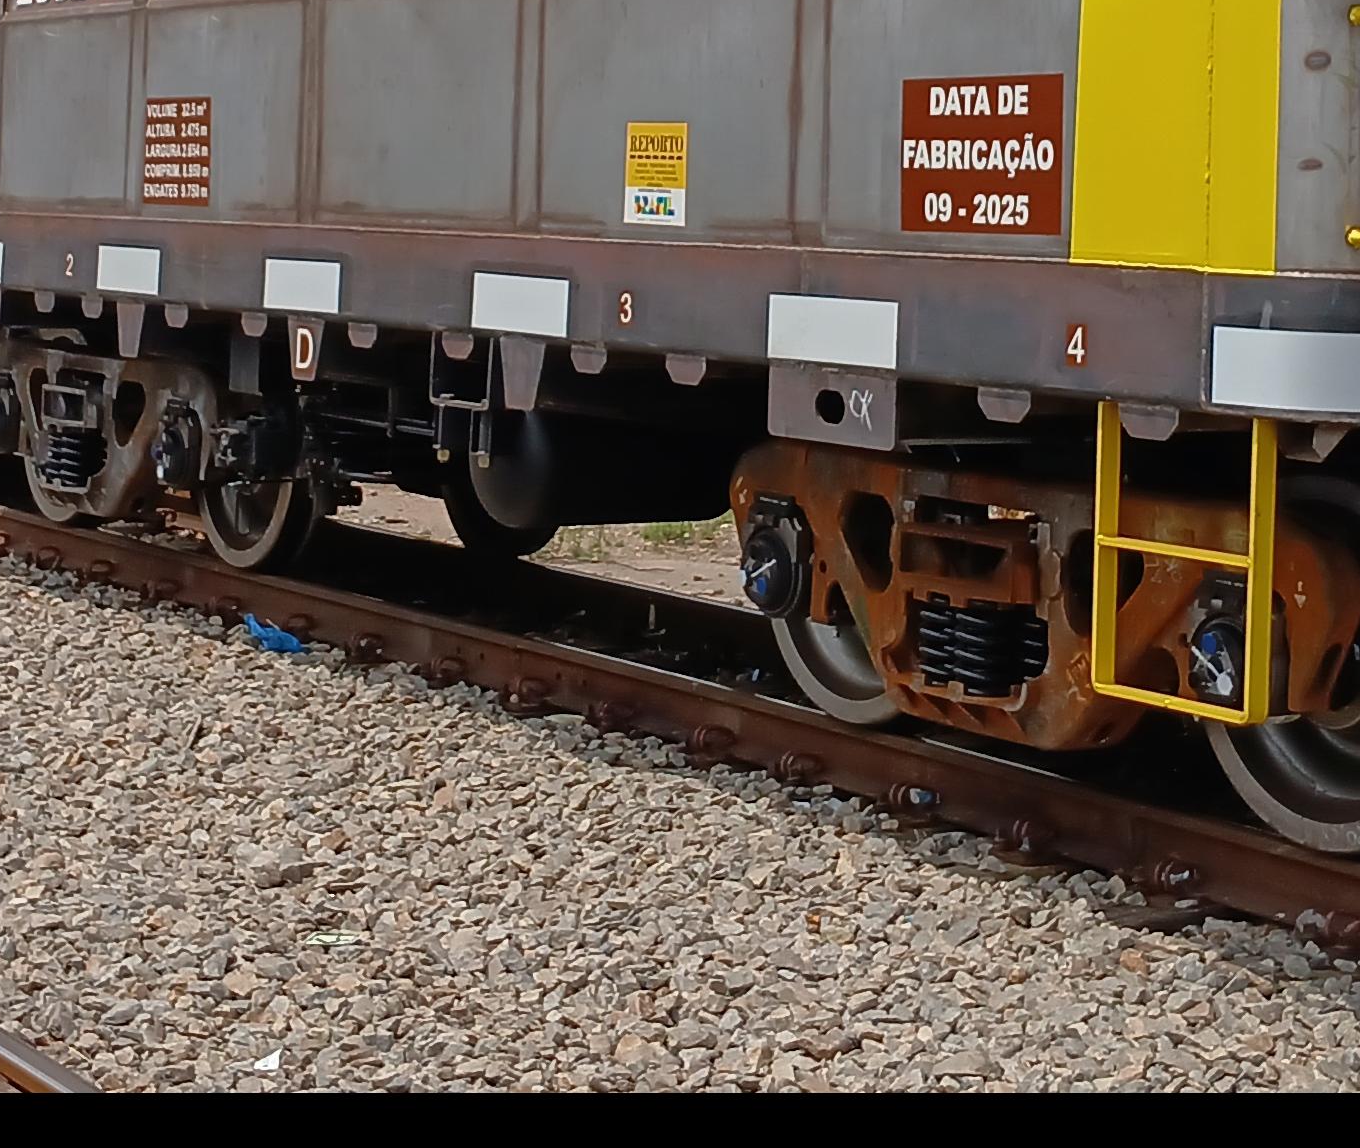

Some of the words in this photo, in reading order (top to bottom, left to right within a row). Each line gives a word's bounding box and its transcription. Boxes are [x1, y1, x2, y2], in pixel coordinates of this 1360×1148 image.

[929, 85, 991, 116] DATA
[997, 84, 1029, 116] DE
[630, 134, 685, 153] REPORTO
[902, 132, 1055, 178] FABRICAÇÃO
[924, 192, 953, 222] 09
[972, 193, 1030, 226] 2025
[64, 253, 74, 277] 2
[620, 293, 632, 323] 3
[295, 327, 314, 369] D
[1067, 326, 1085, 364] 4
